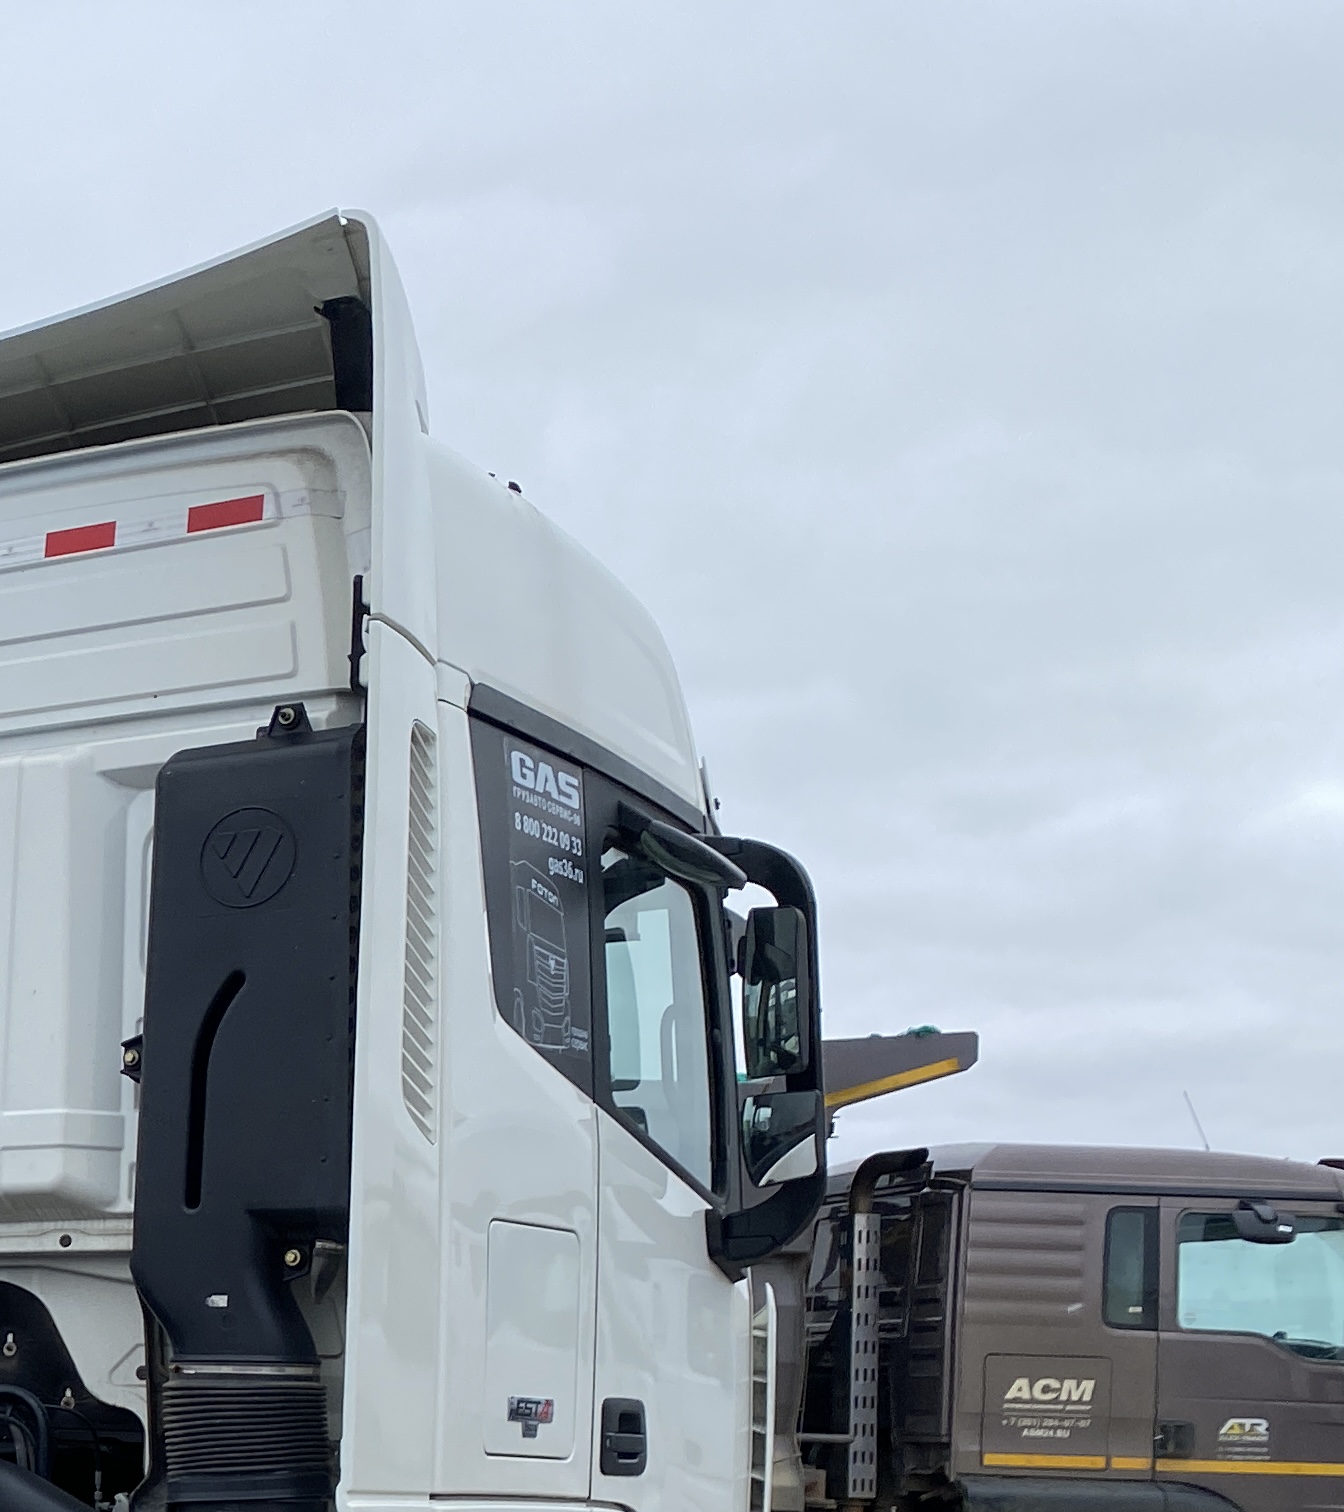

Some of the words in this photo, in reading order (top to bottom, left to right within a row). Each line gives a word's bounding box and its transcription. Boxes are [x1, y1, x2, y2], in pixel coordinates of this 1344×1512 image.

[511, 751, 579, 809] GAS
[514, 811, 522, 831] 8
[522, 815, 541, 839] 800
[541, 822, 559, 847] 222
[559, 831, 571, 851] 09
[571, 836, 582, 857] 33
